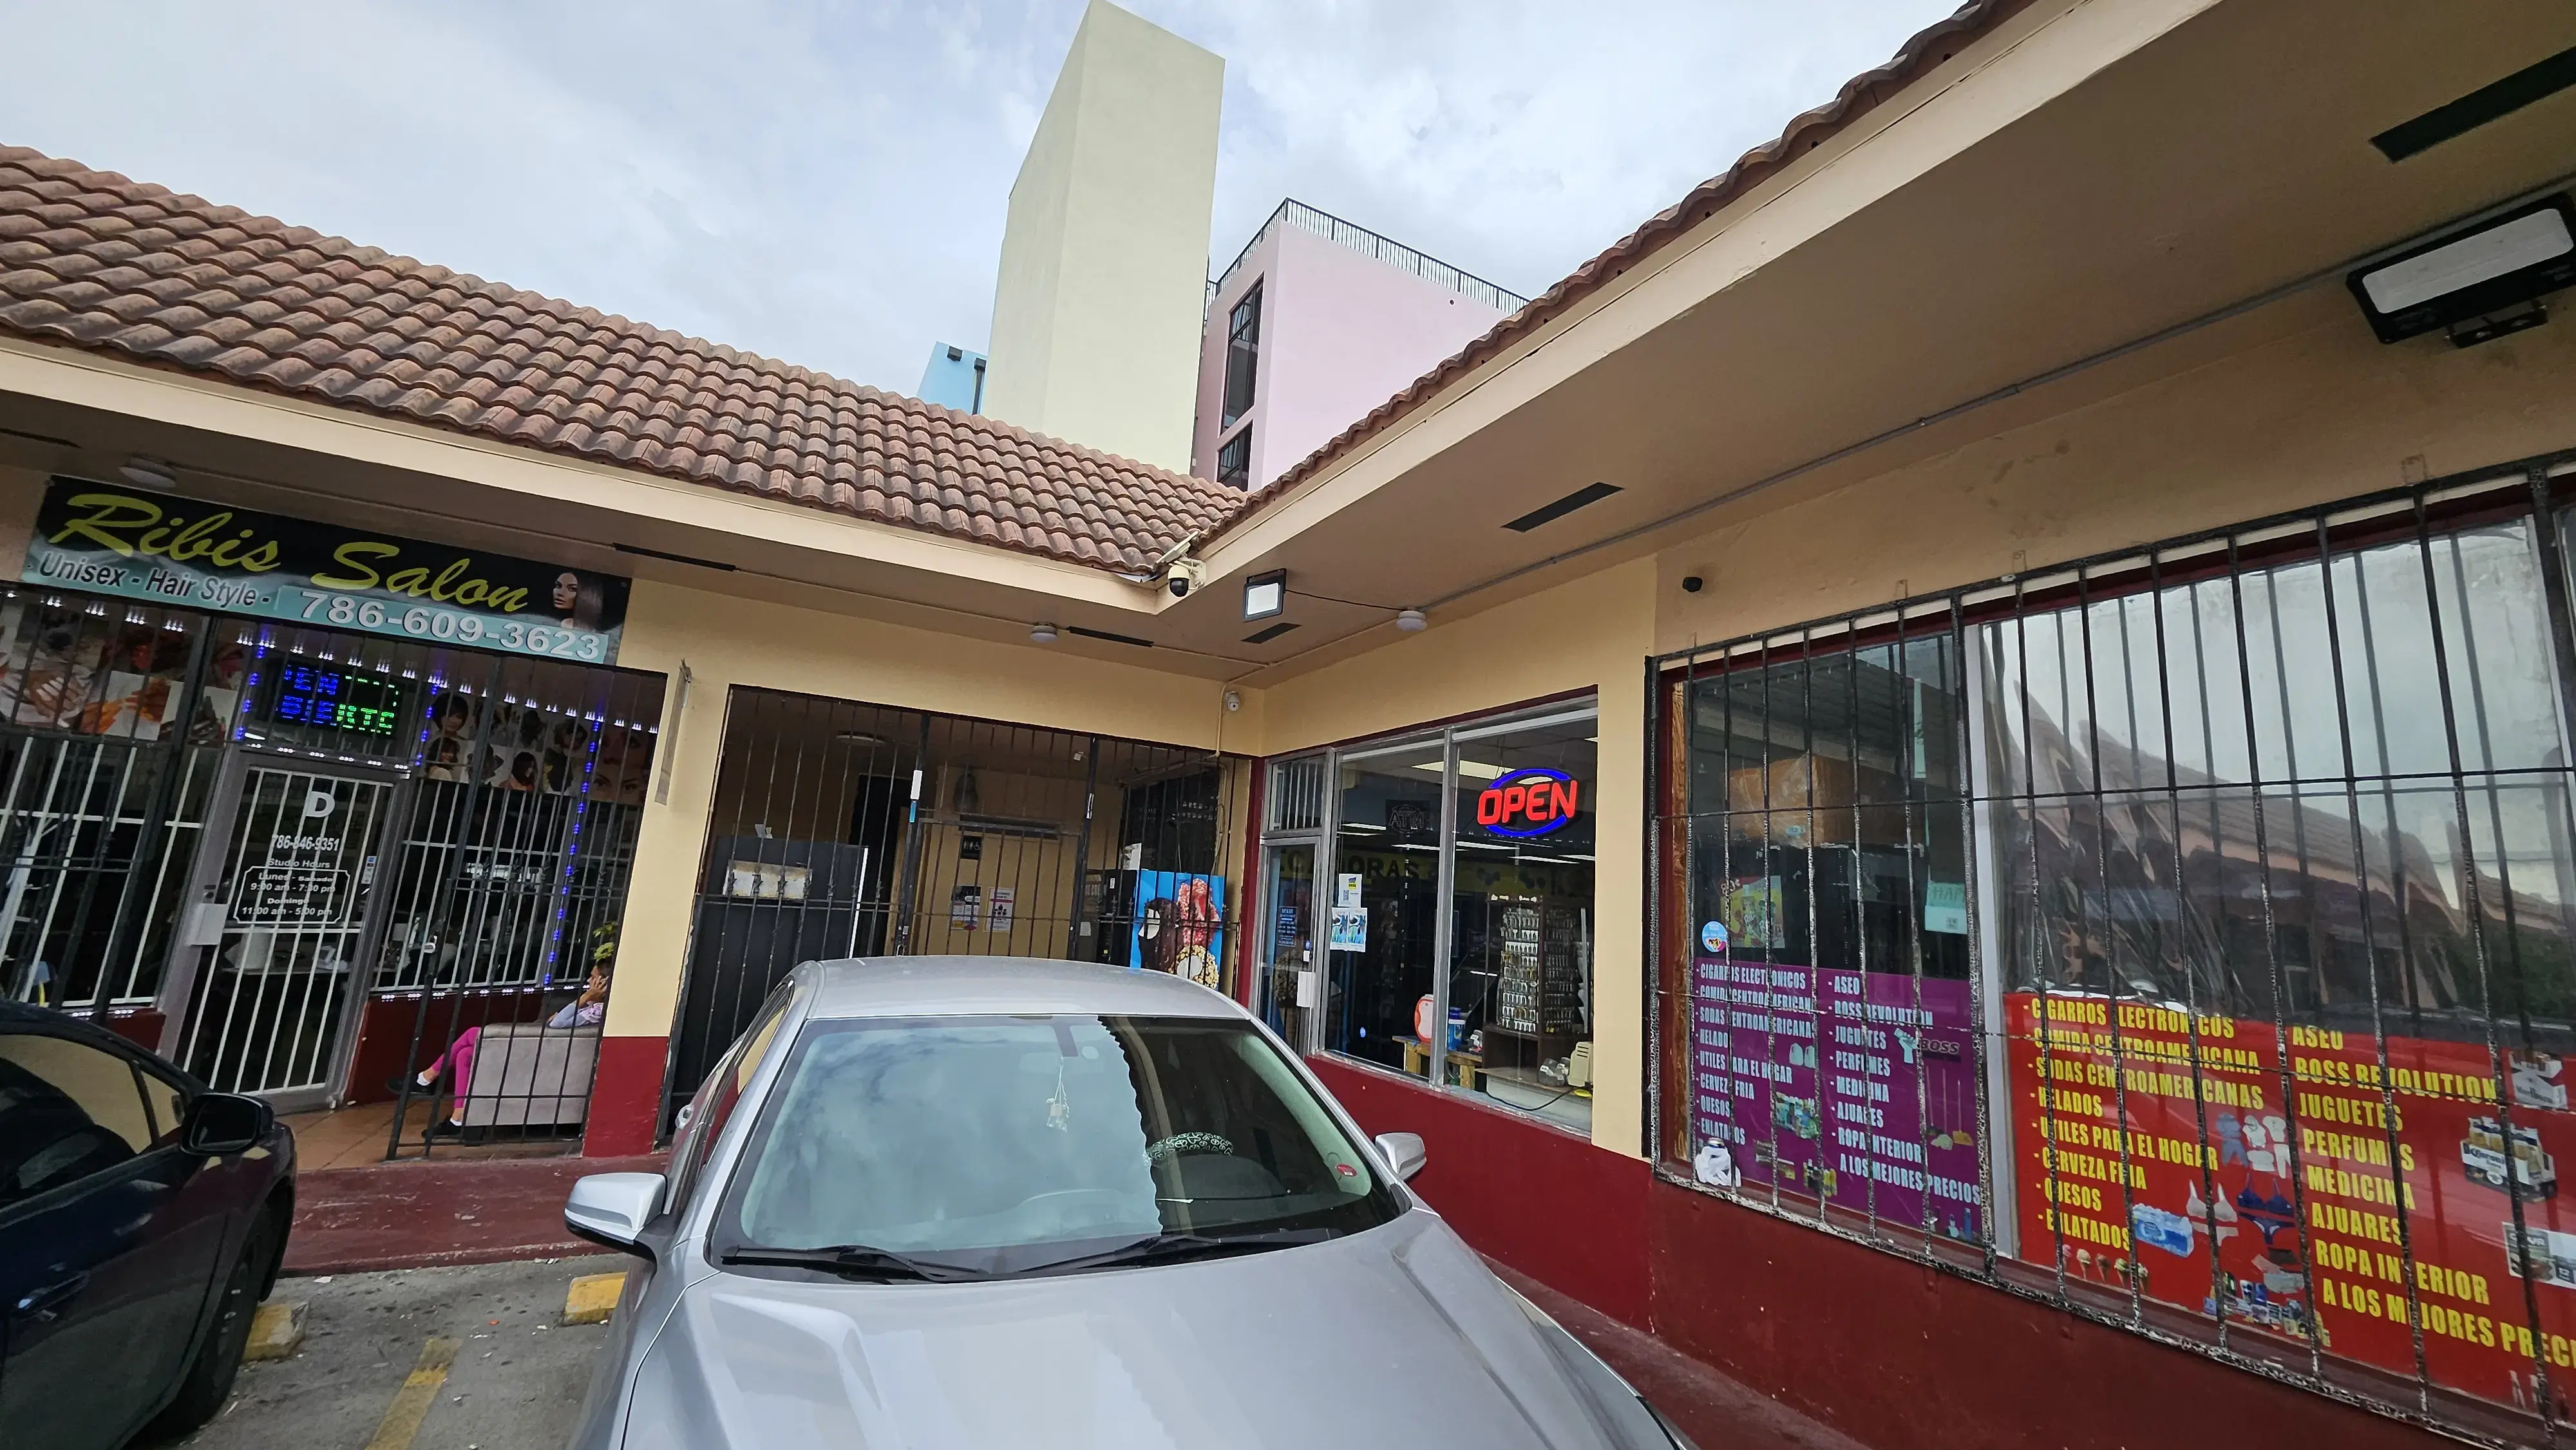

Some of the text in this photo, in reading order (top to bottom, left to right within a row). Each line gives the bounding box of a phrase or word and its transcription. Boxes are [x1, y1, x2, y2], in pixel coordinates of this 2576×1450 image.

[48, 494, 529, 611] Ribis Salon
[40, 551, 127, 587] Unisex
[145, 569, 196, 597] Hair
[200, 577, 256, 608] Style
[301, 591, 600, 660] 786-609-3623
[306, 791, 336, 818] D
[1477, 780, 1578, 825] OPEN
[271, 834, 340, 852] 786-846-9351
[258, 872, 289, 881] Lunes
[268, 858, 330, 869] Studio Hours
[1834, 975, 1860, 995] ASEO
[1700, 1006, 1815, 1039] SODAS ENTROAMERICANA
[1835, 1000, 1862, 1021] BOSS
[2032, 997, 2235, 1039] CGARROS LECTRONCOS
[1700, 1028, 1730, 1049] HELADO
[1835, 1025, 1887, 1050] JUGUTES
[1921, 1038, 1960, 1055] BOSS
[2292, 1025, 2344, 1051] ASEO
[1700, 1050, 1726, 1071] UTILES
[1727, 1055, 1749, 1076] ARA
[1750, 1060, 1760, 1078] EL
[2295, 1057, 2351, 1088] BOSS
[1700, 1072, 1755, 1100] CERVEZ FRIA
[1837, 1075, 1889, 1103] MEDIINA
[2087, 1063, 2264, 1110] CENROAMERCANAS
[1701, 1095, 1730, 1118] QUESOS
[2299, 1092, 2404, 1132] JUGUETES
[1701, 1118, 1746, 1145] ENLATAOS
[1838, 1127, 1922, 1164] ROPA NTERIOR
[2092, 1125, 2134, 1155] PARA
[2137, 1133, 2155, 1159] EL
[2302, 1128, 2415, 1171] PERFUMS
[1840, 1153, 1981, 1205] A LOS MEJORES PRECIOS
[2306, 1164, 2416, 1210] MEDICINA
[2311, 1201, 2403, 1247] AJUARES
[2315, 1239, 2490, 1306] ROPA INERIOR
[2323, 1278, 2337, 1306] A
[2340, 1282, 2382, 1319] LOS
[2385, 1293, 2496, 1348] MJORES
